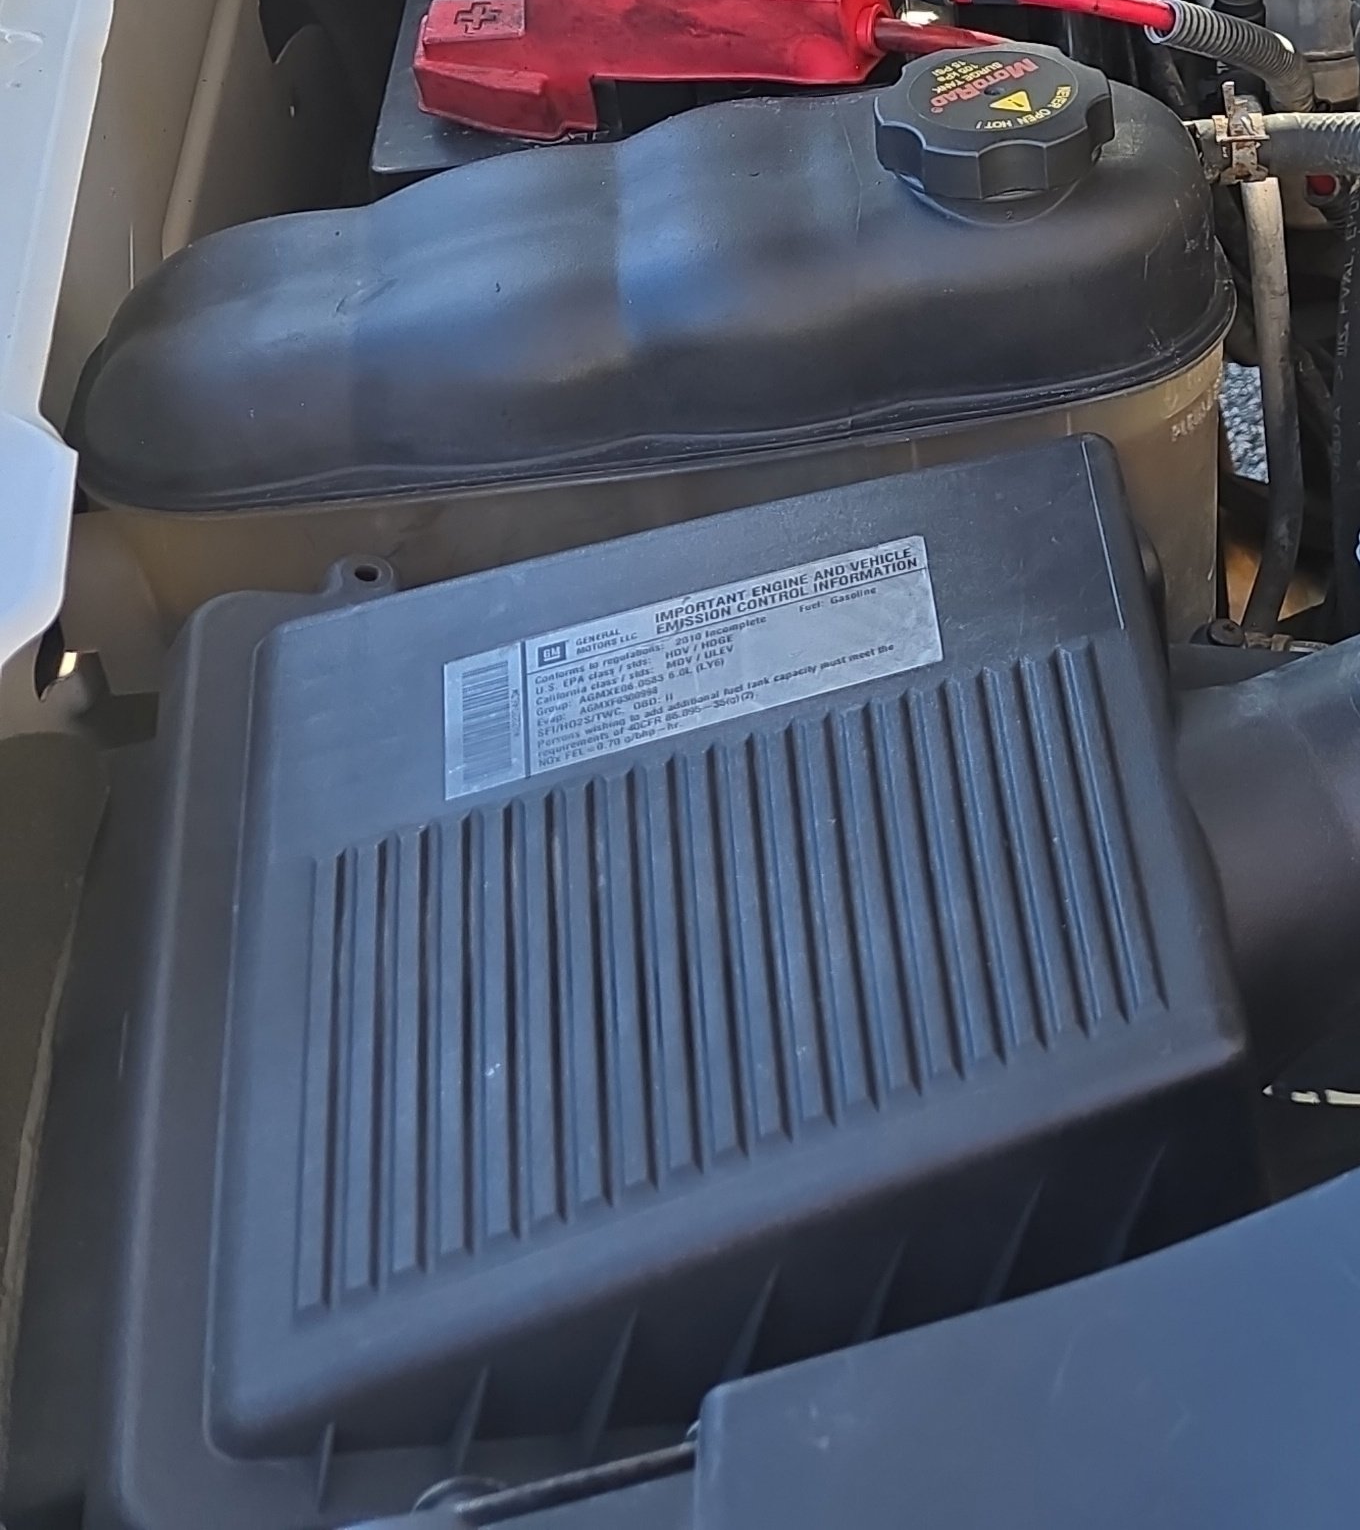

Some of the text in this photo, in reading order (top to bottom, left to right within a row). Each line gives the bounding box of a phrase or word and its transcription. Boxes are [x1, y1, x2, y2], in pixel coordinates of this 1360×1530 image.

[1016, 108, 1051, 126] OPEN
[654, 548, 912, 623] IMPORTANT ENGINE AND VEHICLE
[656, 557, 918, 635] EMISSION CONTROL INFORMATION
[830, 586, 877, 605] Gasoline
